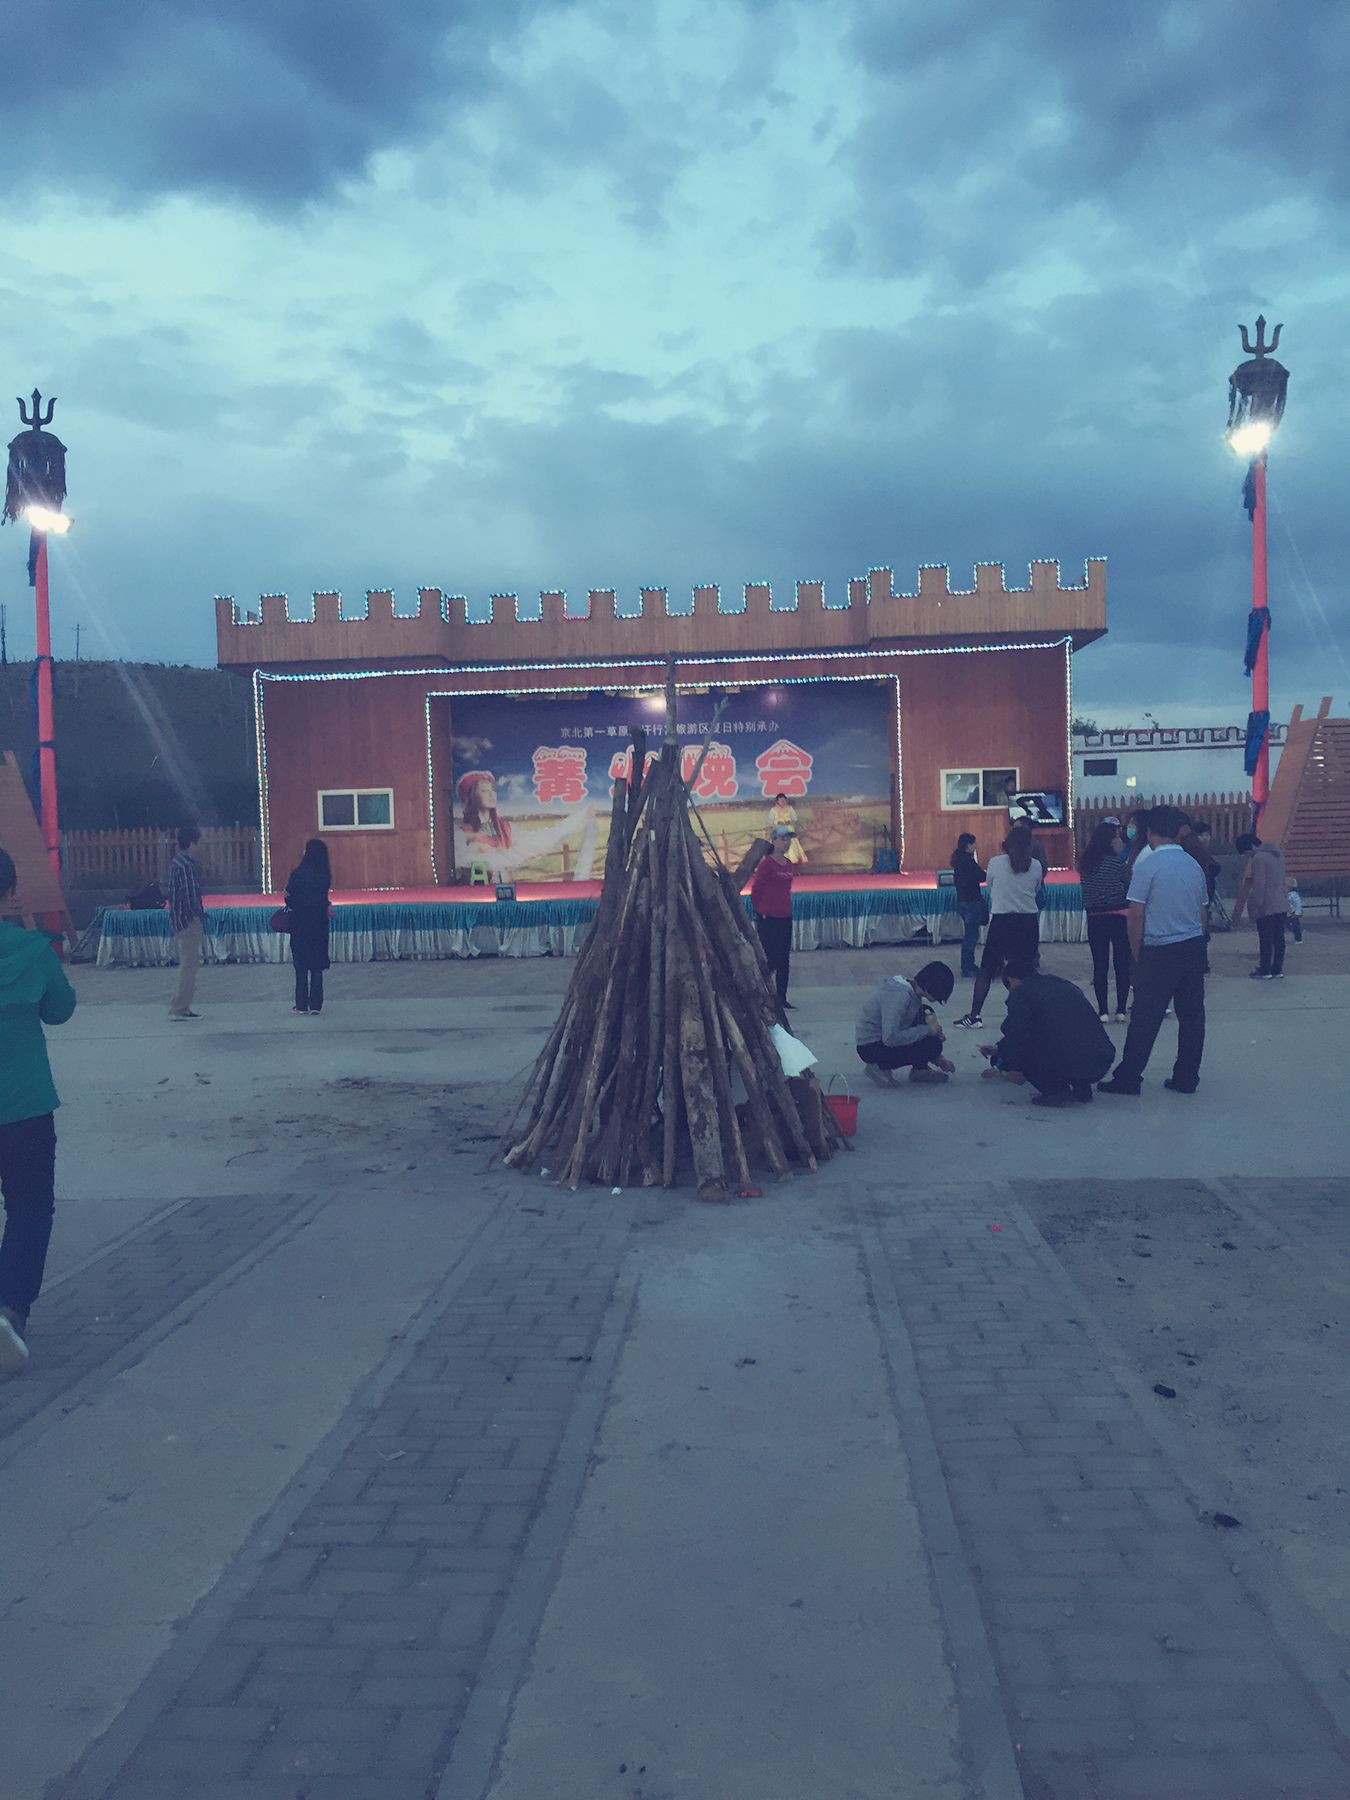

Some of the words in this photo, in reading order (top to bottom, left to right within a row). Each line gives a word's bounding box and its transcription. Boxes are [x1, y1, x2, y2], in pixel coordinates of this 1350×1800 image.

[560, 720, 780, 739] 京北第一草原汗行旅游区日特别承办
